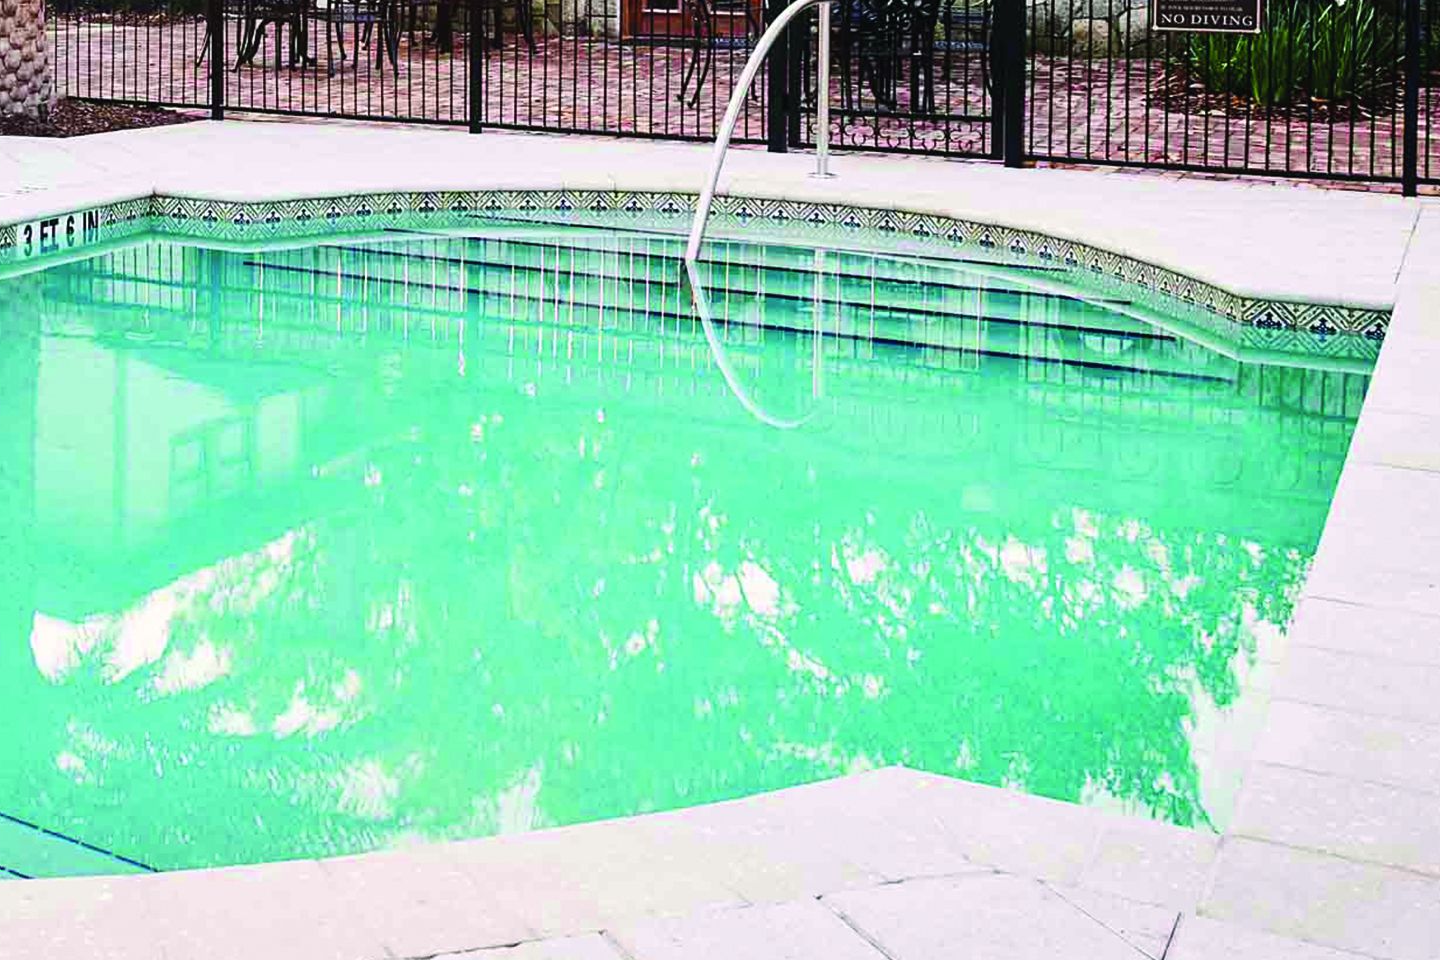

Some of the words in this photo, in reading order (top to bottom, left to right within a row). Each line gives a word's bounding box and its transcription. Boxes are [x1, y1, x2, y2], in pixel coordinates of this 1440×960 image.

[1161, 14, 1185, 24] NO
[1191, 14, 1253, 26] DIVING
[82, 209, 99, 233] IN
